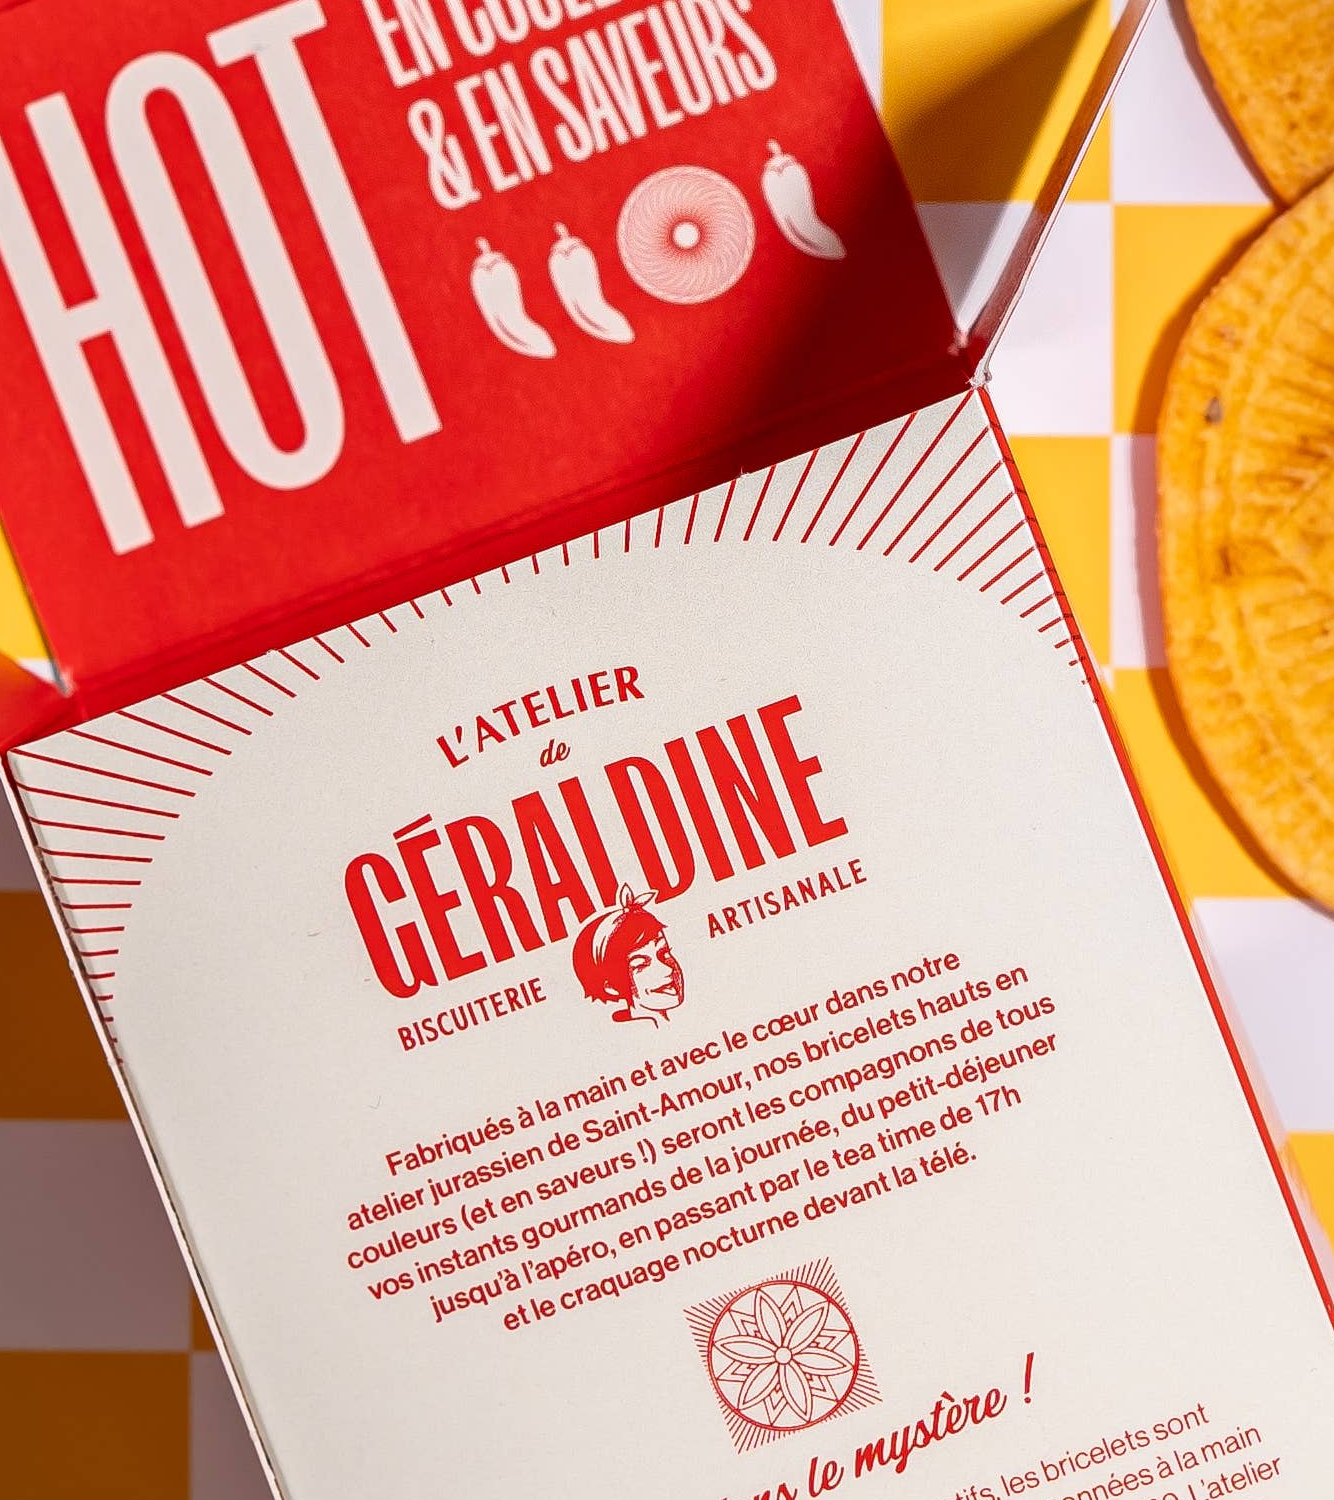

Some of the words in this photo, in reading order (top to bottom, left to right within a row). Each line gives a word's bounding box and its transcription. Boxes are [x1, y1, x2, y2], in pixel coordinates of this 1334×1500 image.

[408, 99, 481, 210] &
[455, 63, 553, 192] EN
[435, 665, 645, 769] L’ATELIER
[539, 738, 571, 768] de
[343, 694, 850, 1000] GÉRALDINE
[396, 977, 547, 1052] BISCUITERIE
[707, 858, 868, 939] ARTISANALE
[347, 1188, 425, 1231] atelier
[427, 1146, 545, 1207] jurassien
[547, 1132, 581, 1158] de
[581, 1071, 752, 1144] Saint-Amour,
[752, 1051, 802, 1082] nos
[801, 1008, 917, 1063] bricelets
[917, 980, 992, 1021] hauts
[995, 967, 1029, 991] en
[347, 1216, 459, 1270] couleurs
[460, 1197, 498, 1232] (et
[500, 1189, 534, 1214] en
[535, 1152, 637, 1201] saveurs
[636, 1138, 657, 1165] !)
[659, 1107, 745, 1155] seront
[744, 1096, 786, 1124] les
[788, 1033, 957, 1108] compagnons
[960, 1019, 993, 1044] de
[995, 996, 1055, 1030] tous
[384, 1117, 515, 1177] Fabriqués
[517, 1106, 535, 1130] à
[534, 1099, 562, 1122] la
[563, 1075, 627, 1112] main
[629, 1060, 658, 1088] et
[660, 1041, 721, 1077] avec
[721, 1031, 748, 1053] le
[752, 1002, 819, 1042] cœur
[825, 979, 889, 1015] dans
[891, 953, 960, 991] notre
[367, 1272, 415, 1301] vos
[414, 1234, 519, 1284] instants
[520, 1179, 667, 1251] gourmands
[669, 1165, 704, 1191] de
[704, 1156, 731, 1178] la
[731, 1119, 840, 1174] journée,
[840, 1102, 875, 1128] du
[876, 1034, 1056, 1120] petit-déjeuner
[428, 1268, 523, 1324] jusqu’à
[520, 1240, 617, 1286] l’apéro,
[618, 1225, 652, 1249] en
[653, 1182, 758, 1242] passant
[758, 1168, 800, 1203] par
[803, 1159, 830, 1181] le
[832, 1143, 876, 1170] tea
[877, 1120, 936, 1153] time
[939, 1105, 973, 1131] de
[974, 1085, 1022, 1116] 17h
[503, 1304, 531, 1331] et
[529, 1298, 557, 1321] le
[559, 1254, 680, 1311] craquage
[682, 1210, 800, 1266] nocturne
[803, 1172, 892, 1221] devant
[891, 1166, 918, 1188] la
[919, 1142, 977, 1177] télé.
[807, 1456, 845, 1499] le
[854, 1387, 1008, 1480] mystère
[1023, 1352, 1035, 1405] !
[1000, 1471, 1040, 1496] les
[1040, 1430, 1151, 1484] bricelets
[1152, 1404, 1210, 1442] sont
[1156, 1456, 1175, 1479] à
[1173, 1450, 1200, 1472] la
[1200, 1428, 1261, 1463] main
